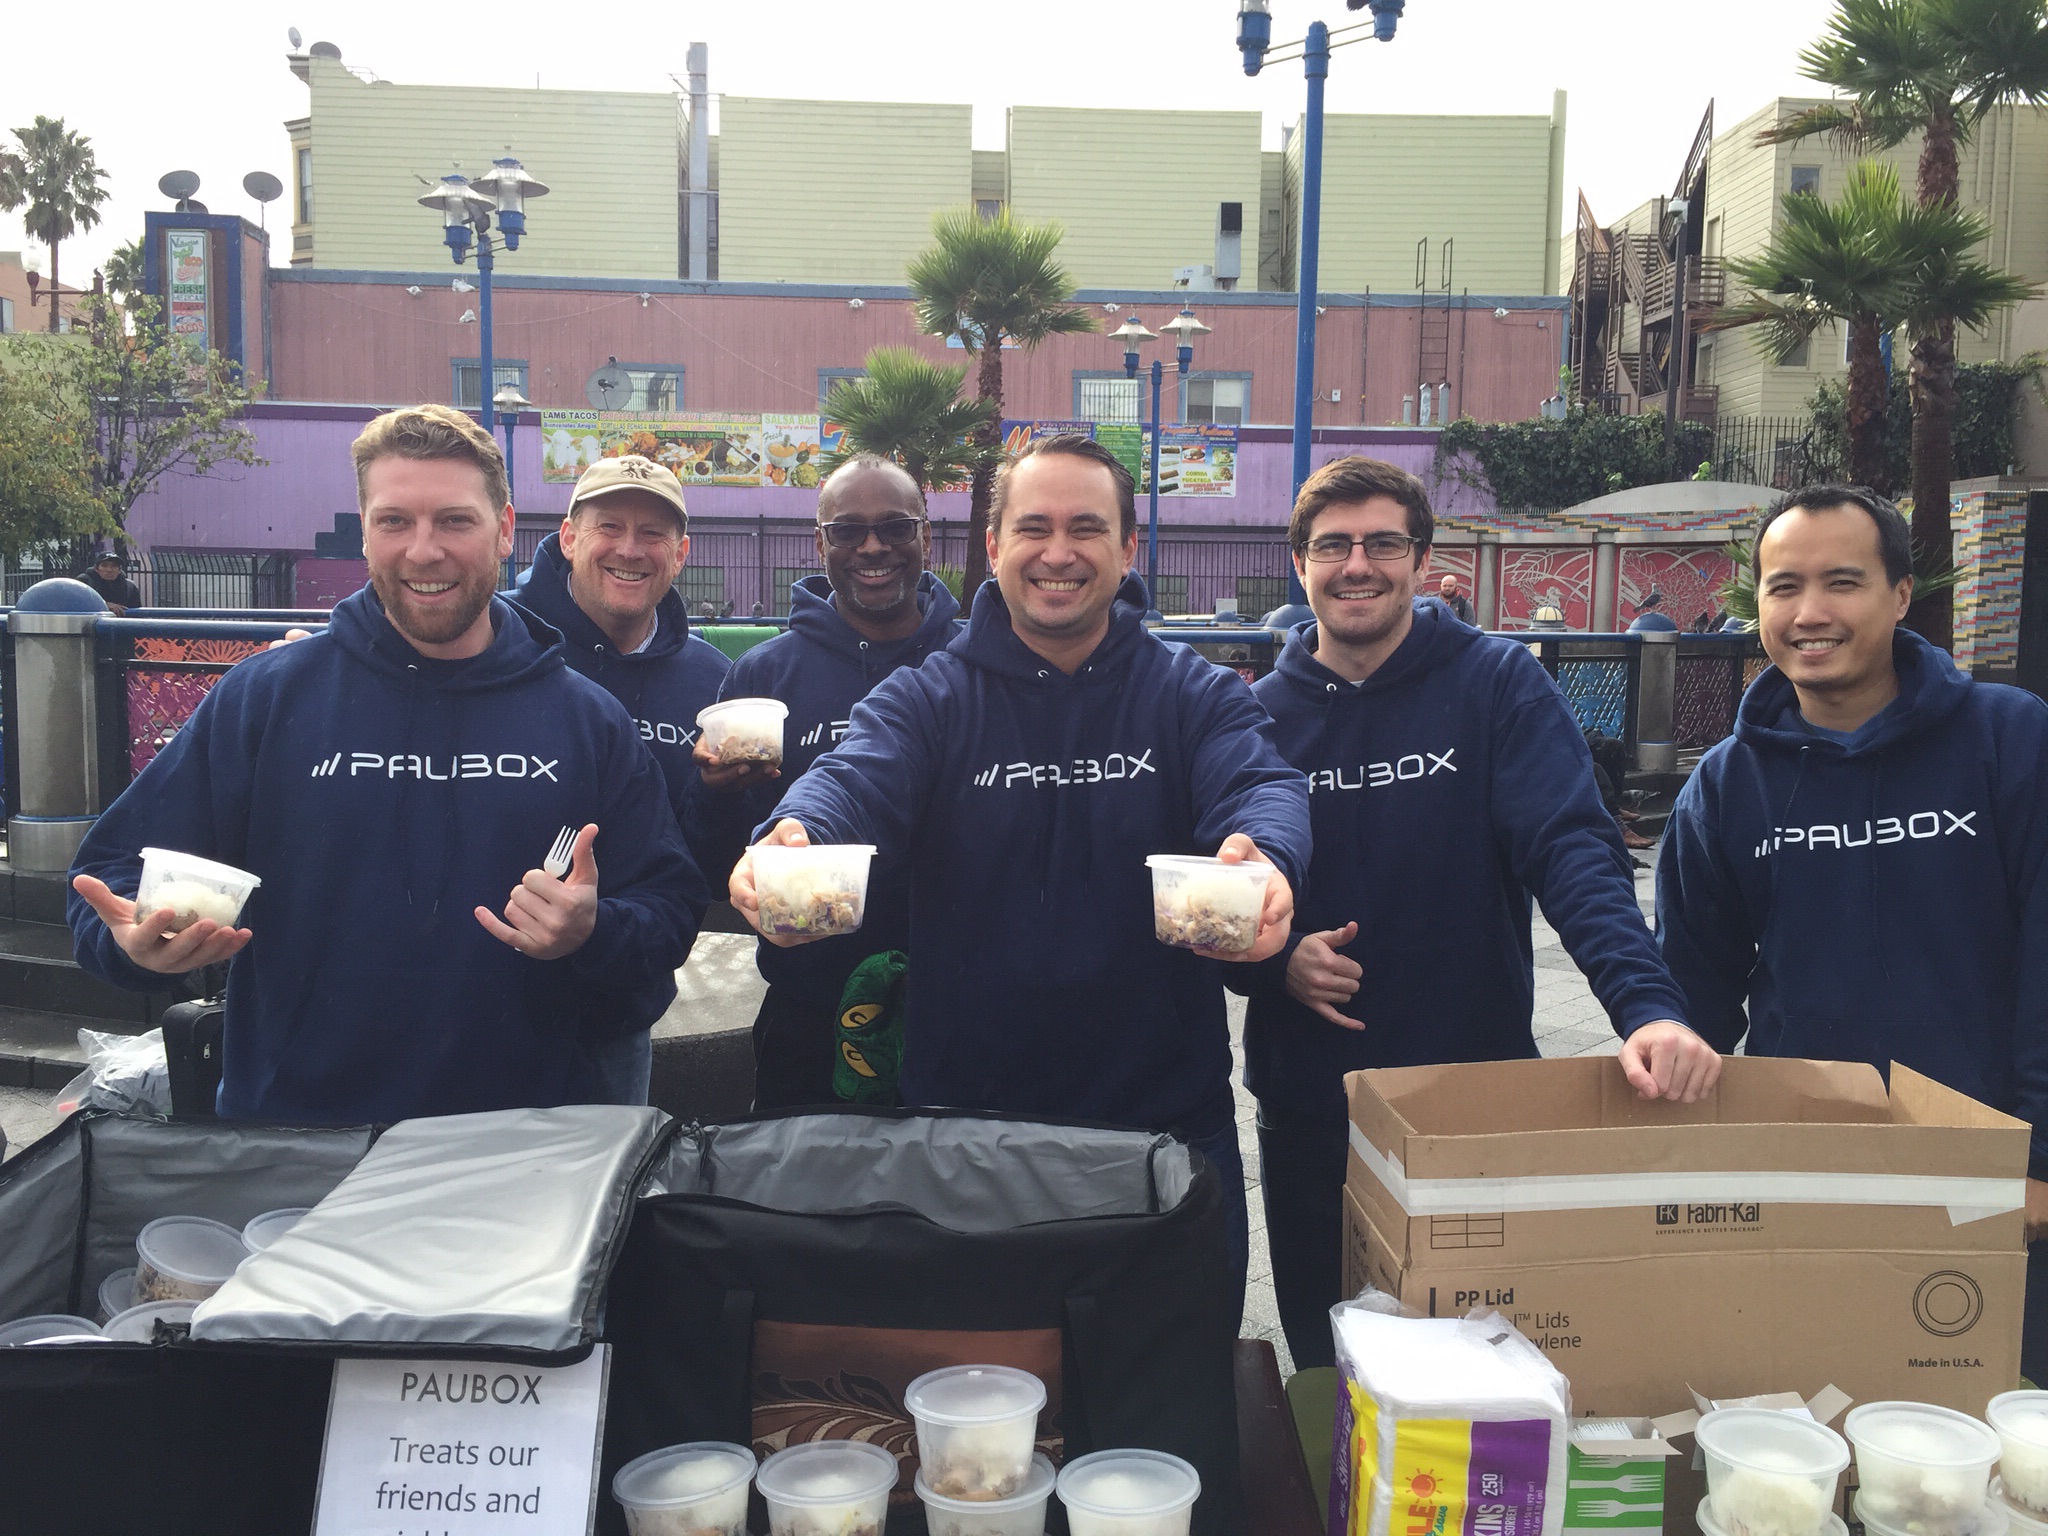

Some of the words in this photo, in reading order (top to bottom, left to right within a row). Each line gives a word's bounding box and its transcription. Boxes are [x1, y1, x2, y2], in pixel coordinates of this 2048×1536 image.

[173, 284, 204, 293] FRESH
[543, 412, 566, 420] LAMB
[569, 412, 598, 420] TACOS
[765, 415, 795, 425] SALSA
[798, 415, 817, 425] BAR
[640, 719, 696, 748] BOX
[351, 752, 559, 782] PAUBOX
[1308, 748, 1458, 794] AUBOX
[1774, 809, 1977, 850] PAUBOX
[1455, 1290, 1480, 1307] PP
[1485, 1288, 1514, 1306] Lid
[1536, 1312, 1570, 1329] Lids
[1908, 1358, 1938, 1367] Made
[1940, 1358, 1950, 1367] in
[1953, 1358, 1984, 1367] U.S.A.
[401, 1373, 542, 1404] PAUBOX
[390, 1437, 479, 1465] Treats
[489, 1446, 539, 1466] our
[376, 1481, 476, 1512] friends
[485, 1487, 540, 1514] and
[1482, 1473, 1498, 1496] 250
[1434, 1505, 1448, 1533] save
[1504, 1505, 1518, 1536] SORBENT
